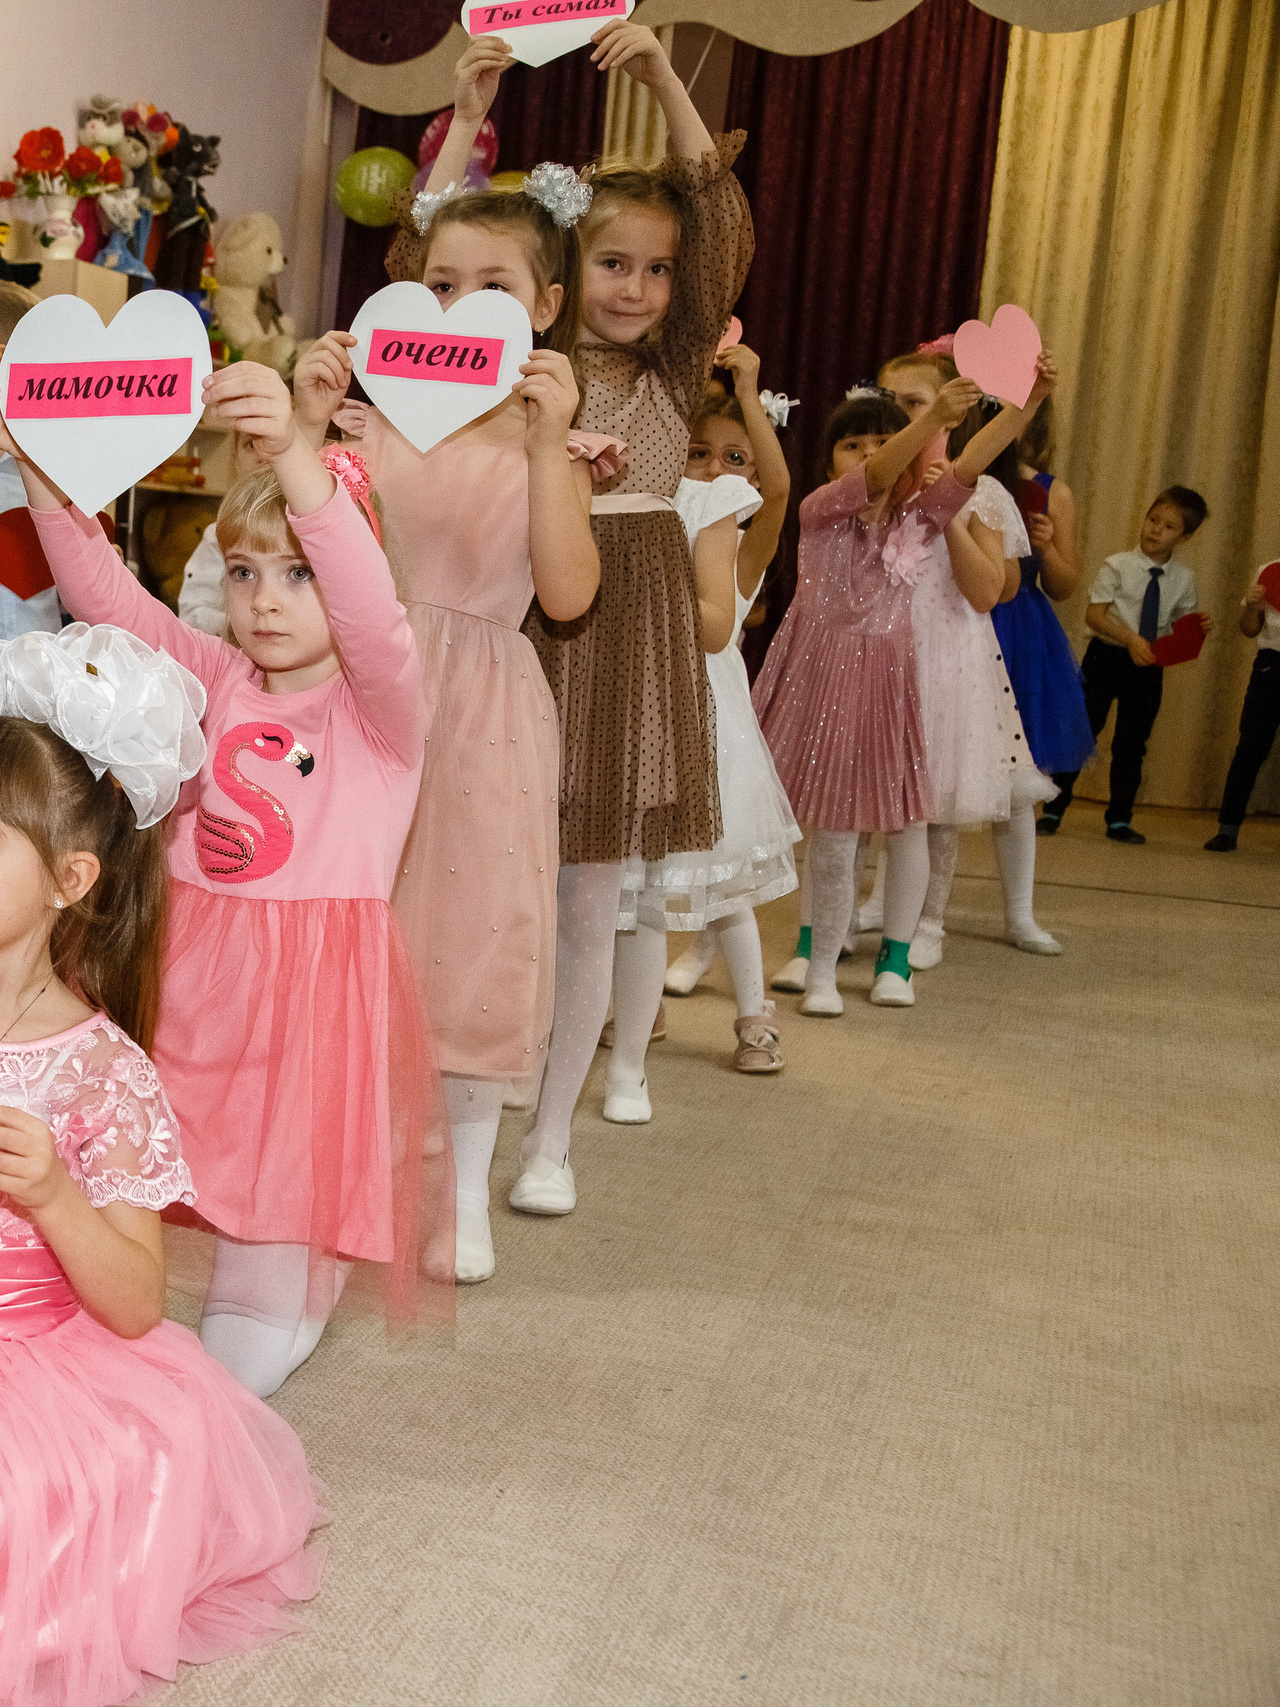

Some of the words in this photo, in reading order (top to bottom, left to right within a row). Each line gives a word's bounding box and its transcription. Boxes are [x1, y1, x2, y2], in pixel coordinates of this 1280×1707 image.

[484, 6, 522, 24] Ты
[532, 0, 617, 16] самая
[381, 340, 488, 371] очень
[17, 373, 178, 402] мамочка
